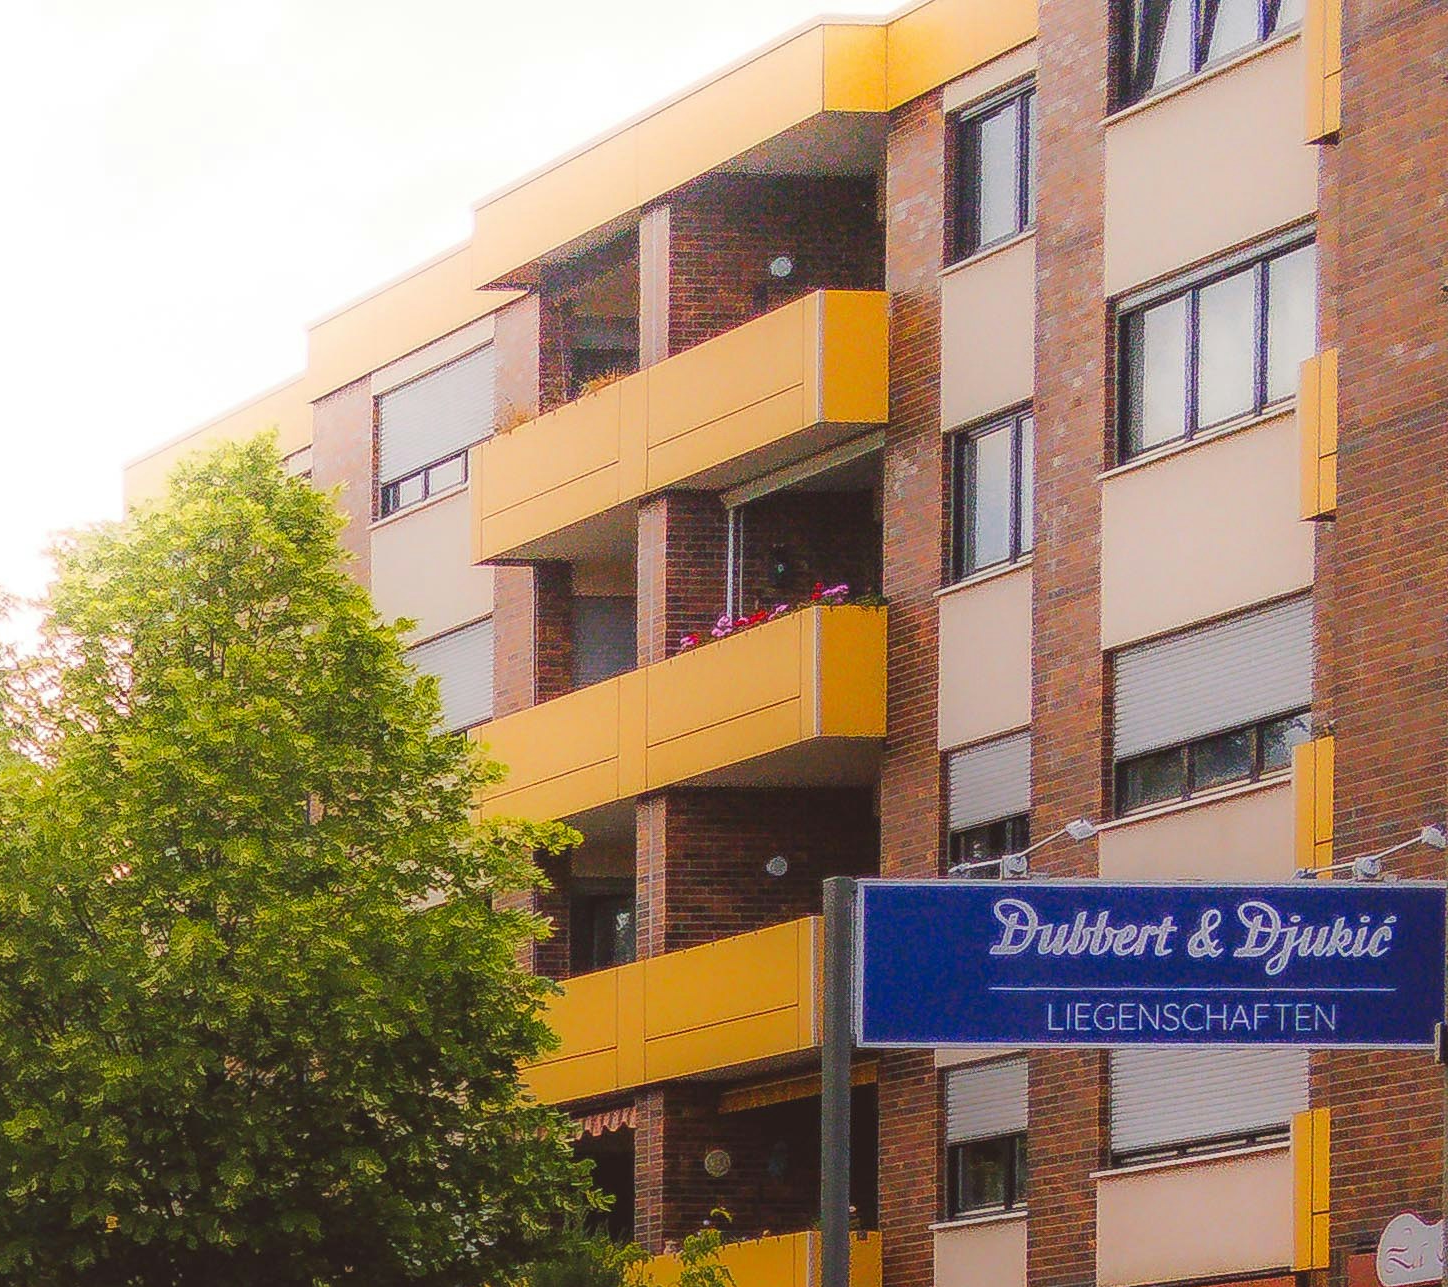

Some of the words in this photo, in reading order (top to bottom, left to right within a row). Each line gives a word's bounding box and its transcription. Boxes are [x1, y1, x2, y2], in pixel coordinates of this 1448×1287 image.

[990, 898, 1178, 956] Dubbert
[1187, 908, 1225, 958] &
[1047, 1002, 1337, 1032] LIEGENSCHAFTEN
